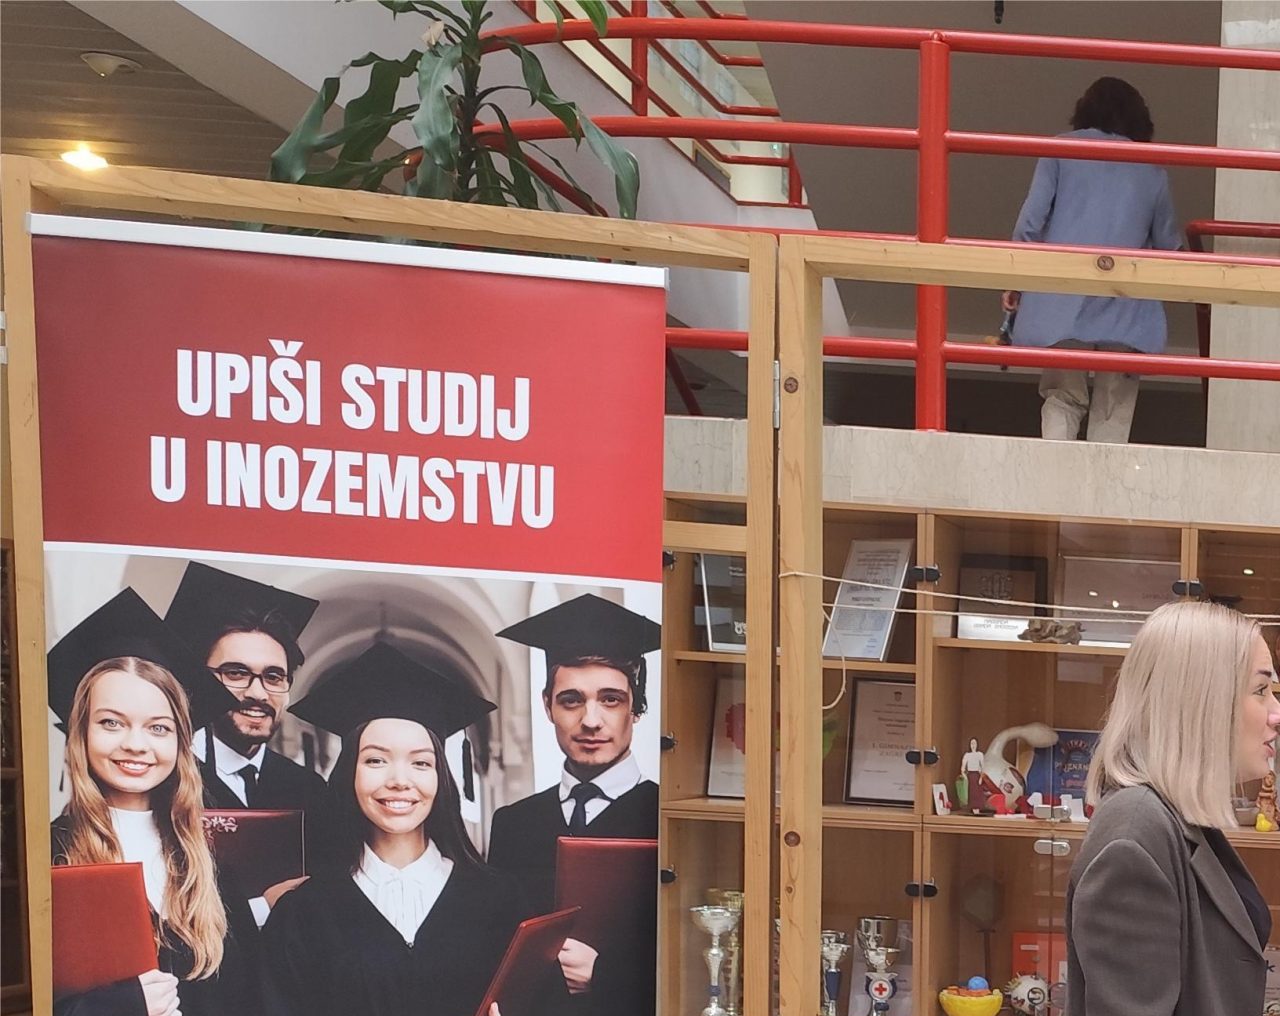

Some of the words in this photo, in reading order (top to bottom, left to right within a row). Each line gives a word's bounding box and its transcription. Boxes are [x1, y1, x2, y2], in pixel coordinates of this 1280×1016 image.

[176, 338, 322, 427] UPIŠI
[341, 363, 530, 441] STUDIJ
[150, 435, 187, 503] U
[206, 438, 555, 529] INOZEMSTVU
